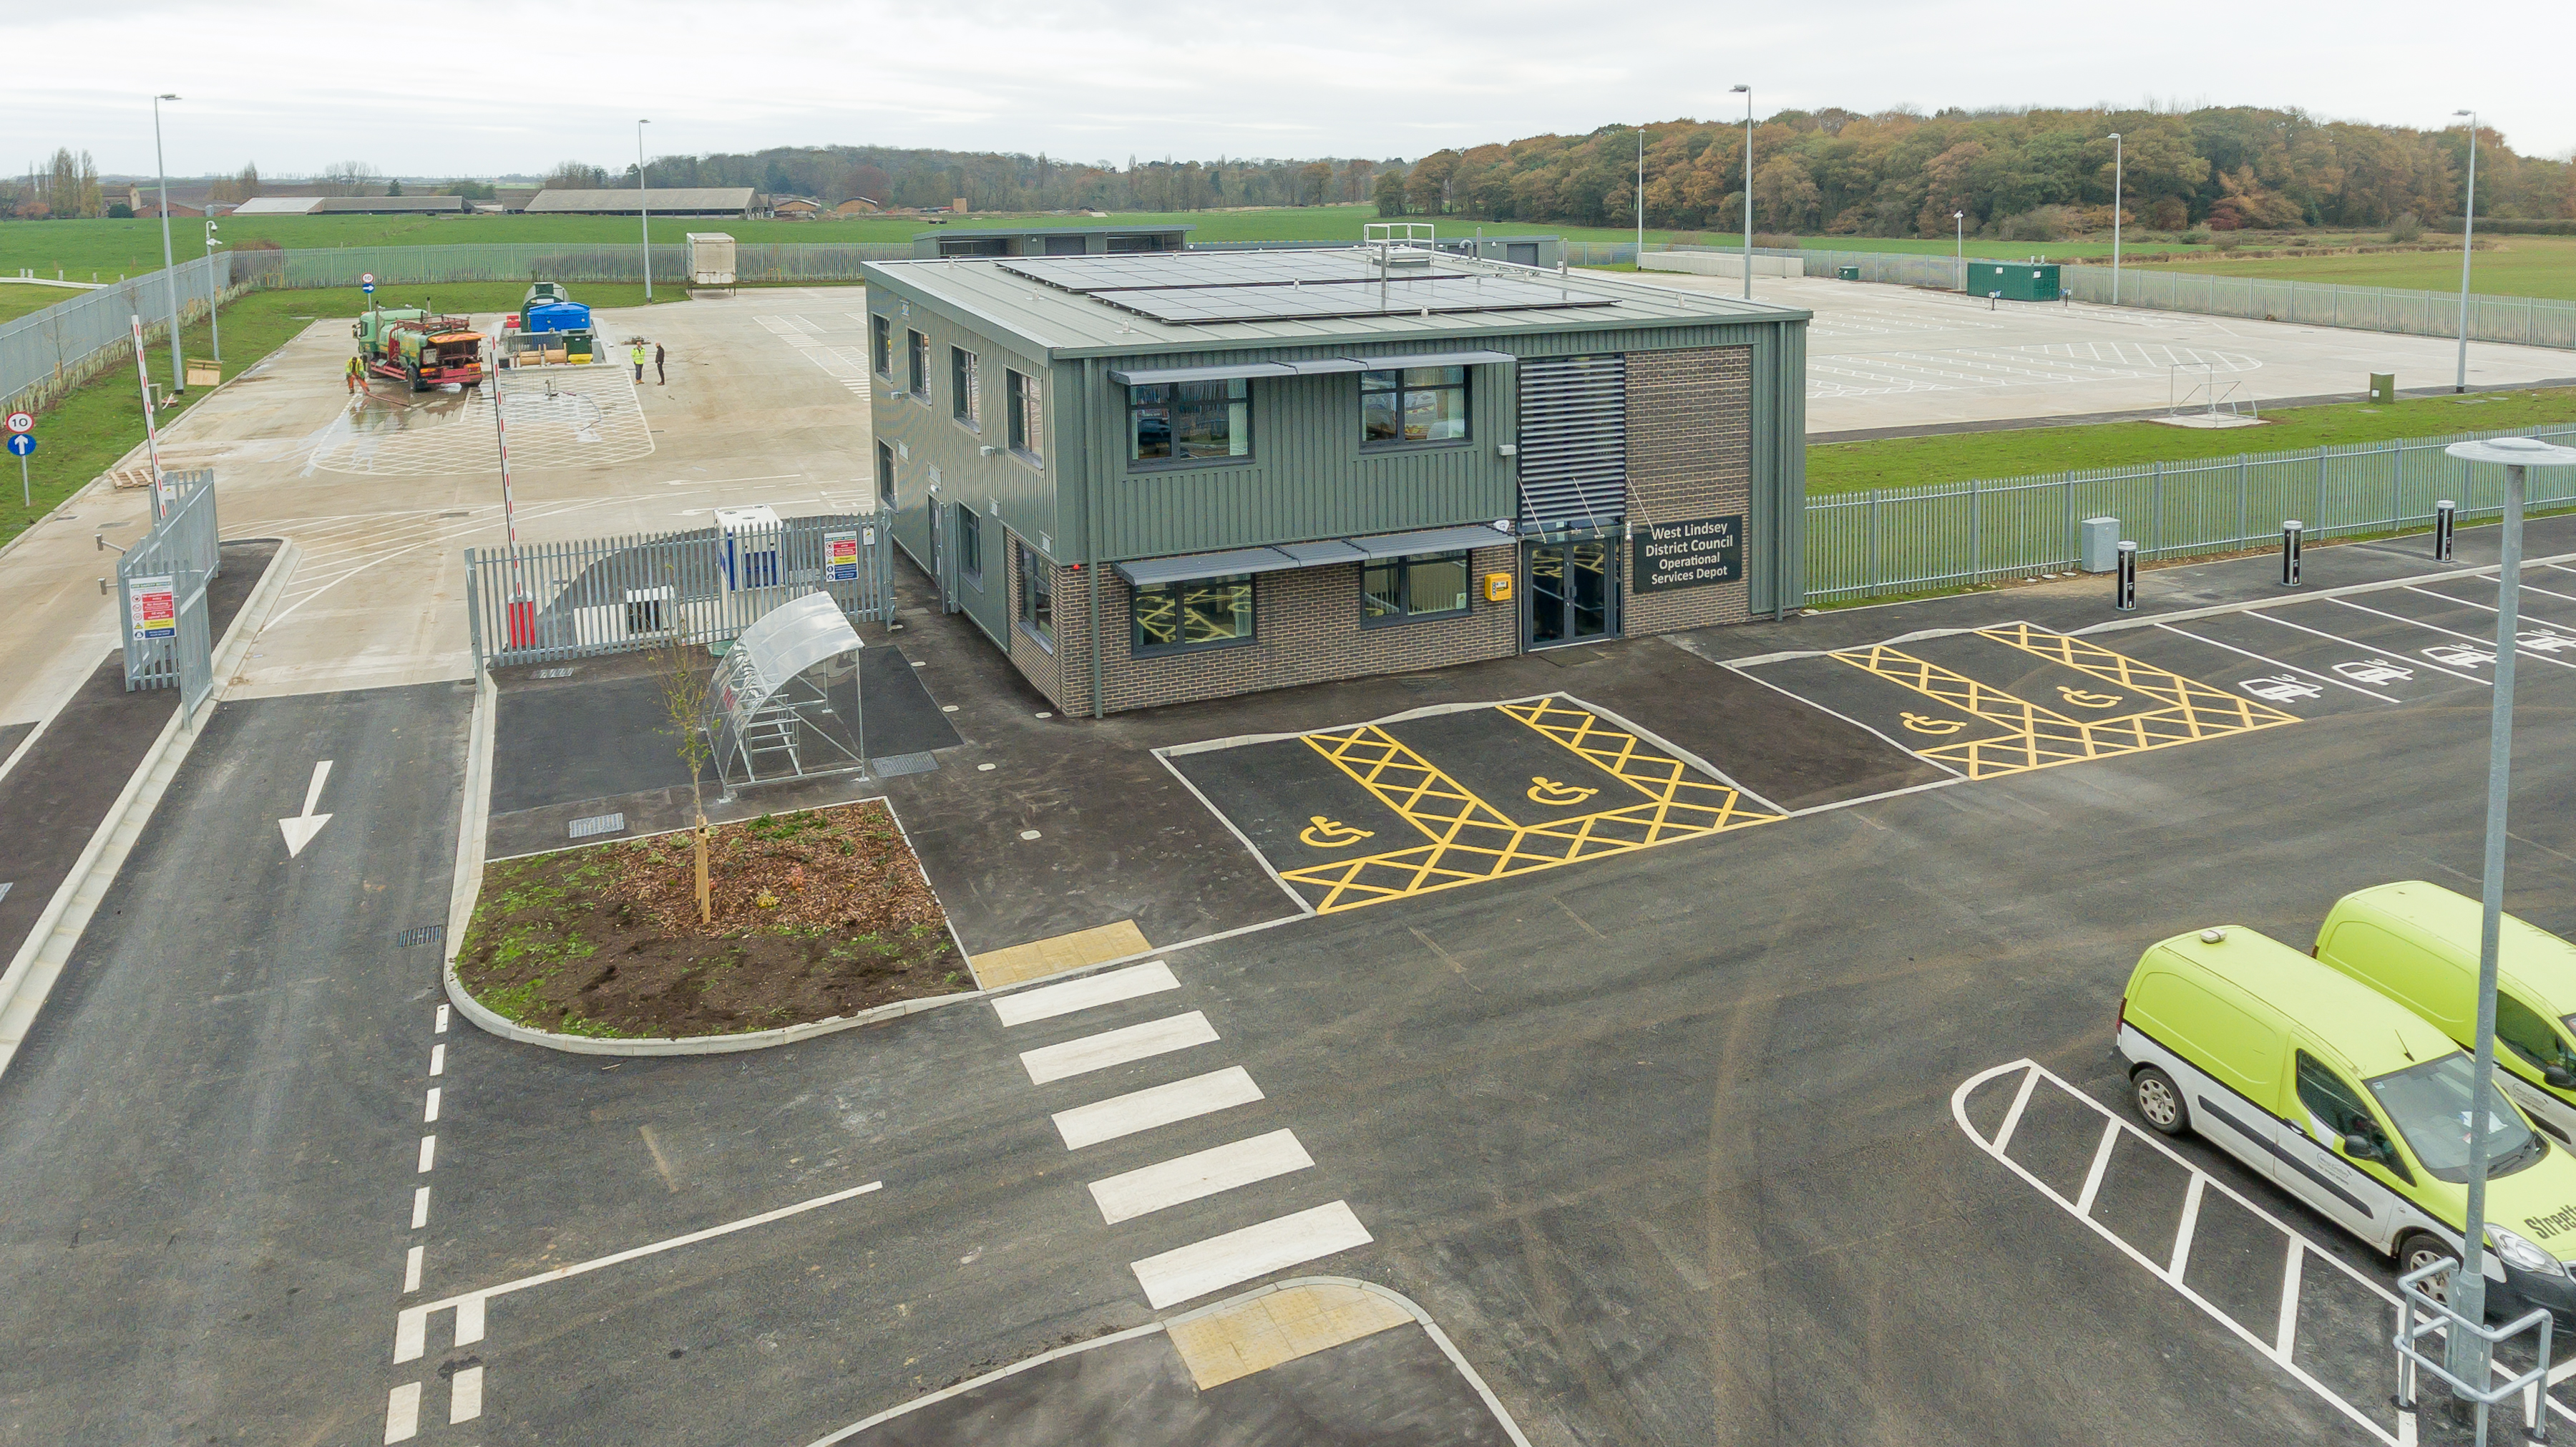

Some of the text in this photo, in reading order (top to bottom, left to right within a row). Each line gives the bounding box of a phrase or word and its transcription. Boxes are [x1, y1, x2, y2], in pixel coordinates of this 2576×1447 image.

[12, 418, 28, 427] 10
[1652, 522, 1728, 540] West Lindsey
[1646, 535, 1733, 557] District Council
[1659, 551, 1720, 571] Operational
[1652, 565, 1728, 585] Services Depot
[2524, 1204, 2576, 1239] Street
